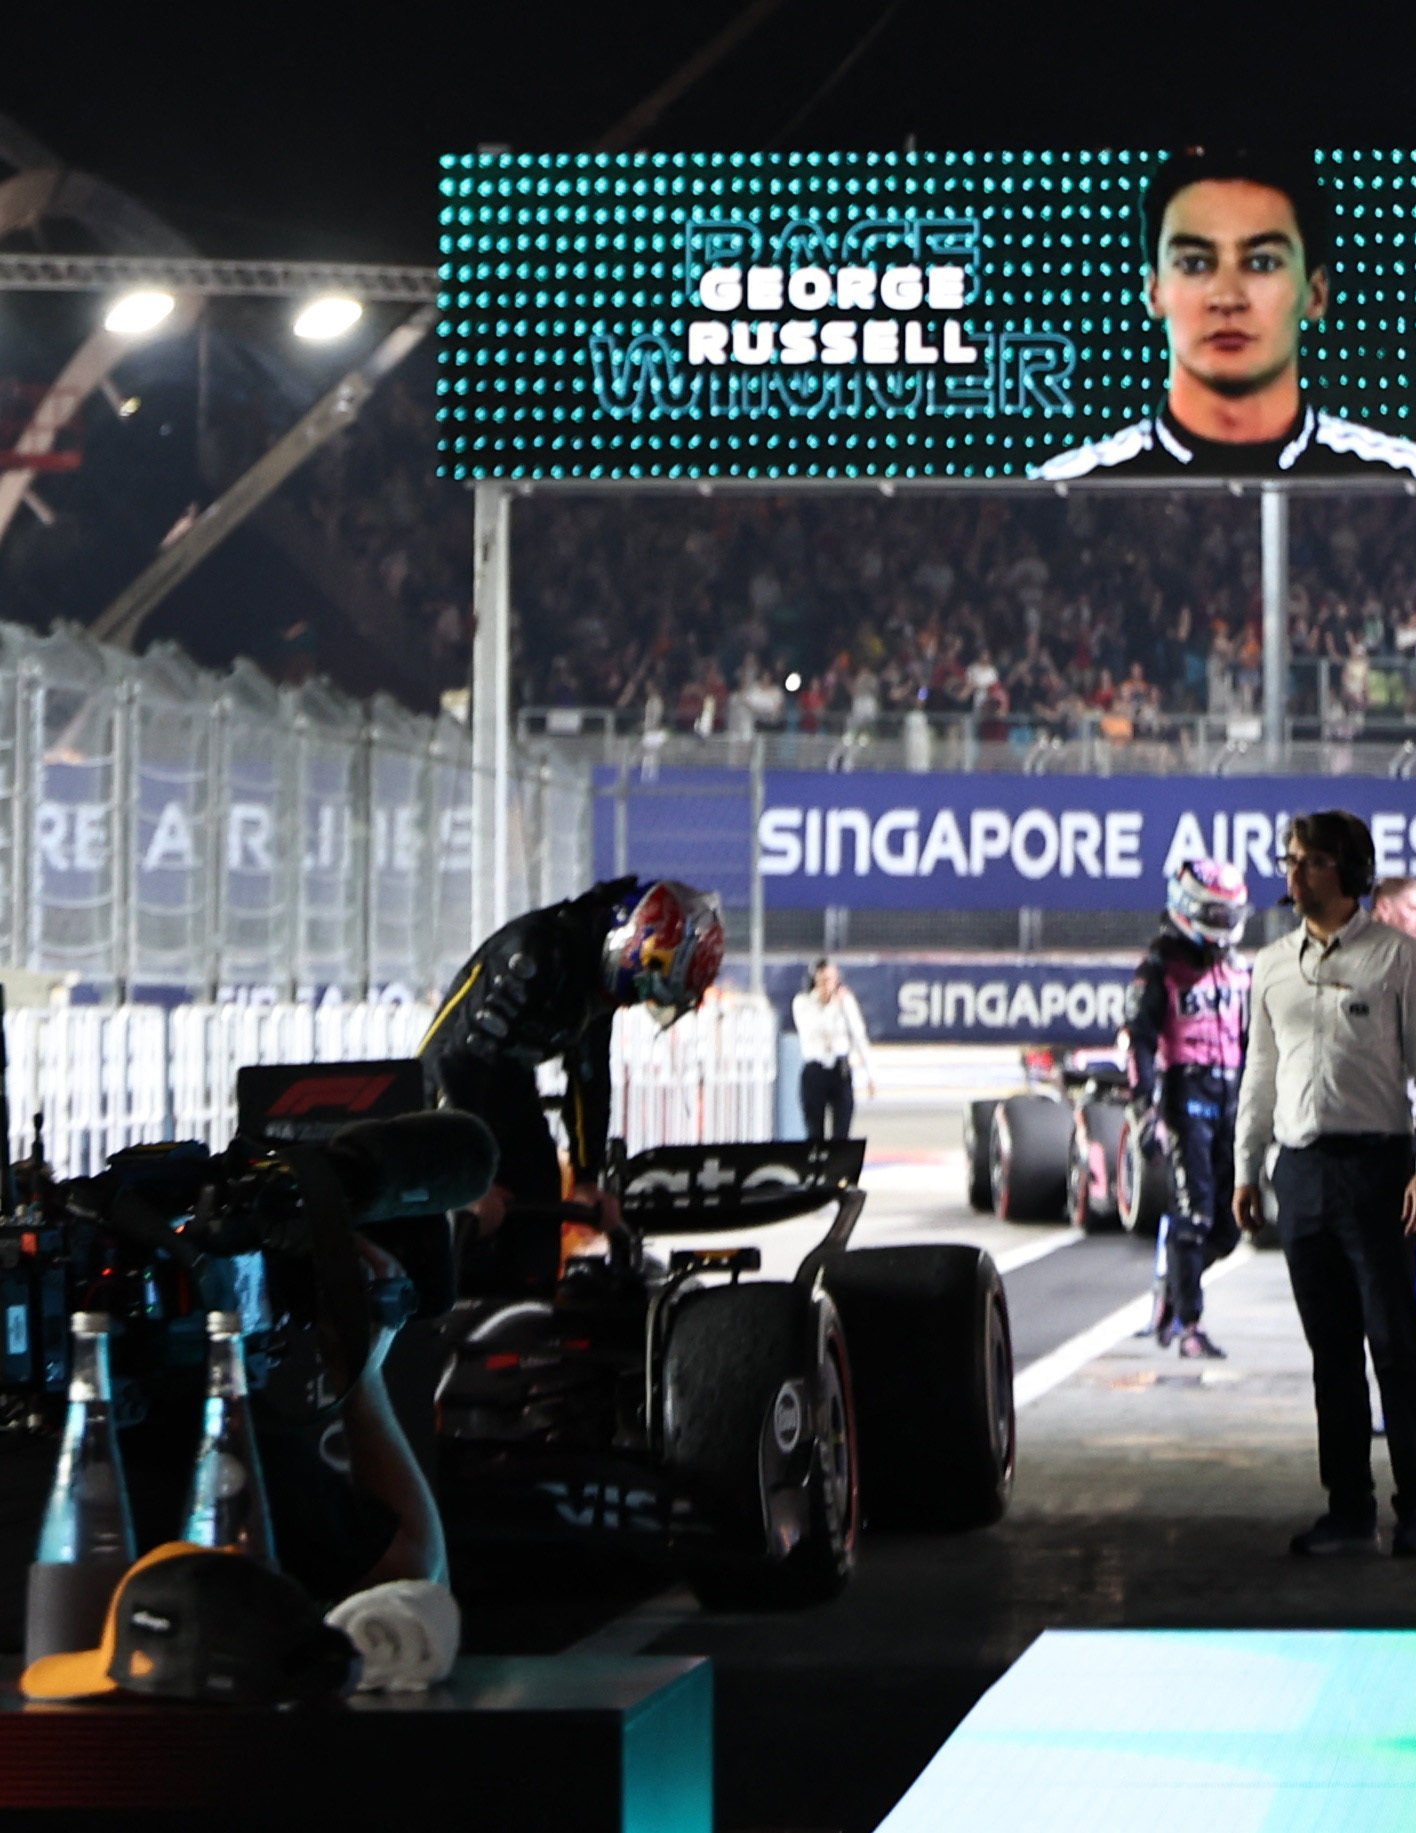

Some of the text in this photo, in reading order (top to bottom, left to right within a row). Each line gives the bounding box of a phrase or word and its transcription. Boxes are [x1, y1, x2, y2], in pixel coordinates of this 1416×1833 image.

[698, 266, 966, 311] GEORGE
[688, 320, 977, 365] RUSSELL
[757, 808, 1144, 879] SINGAPORE
[897, 981, 1127, 1029] SINGAPOR
